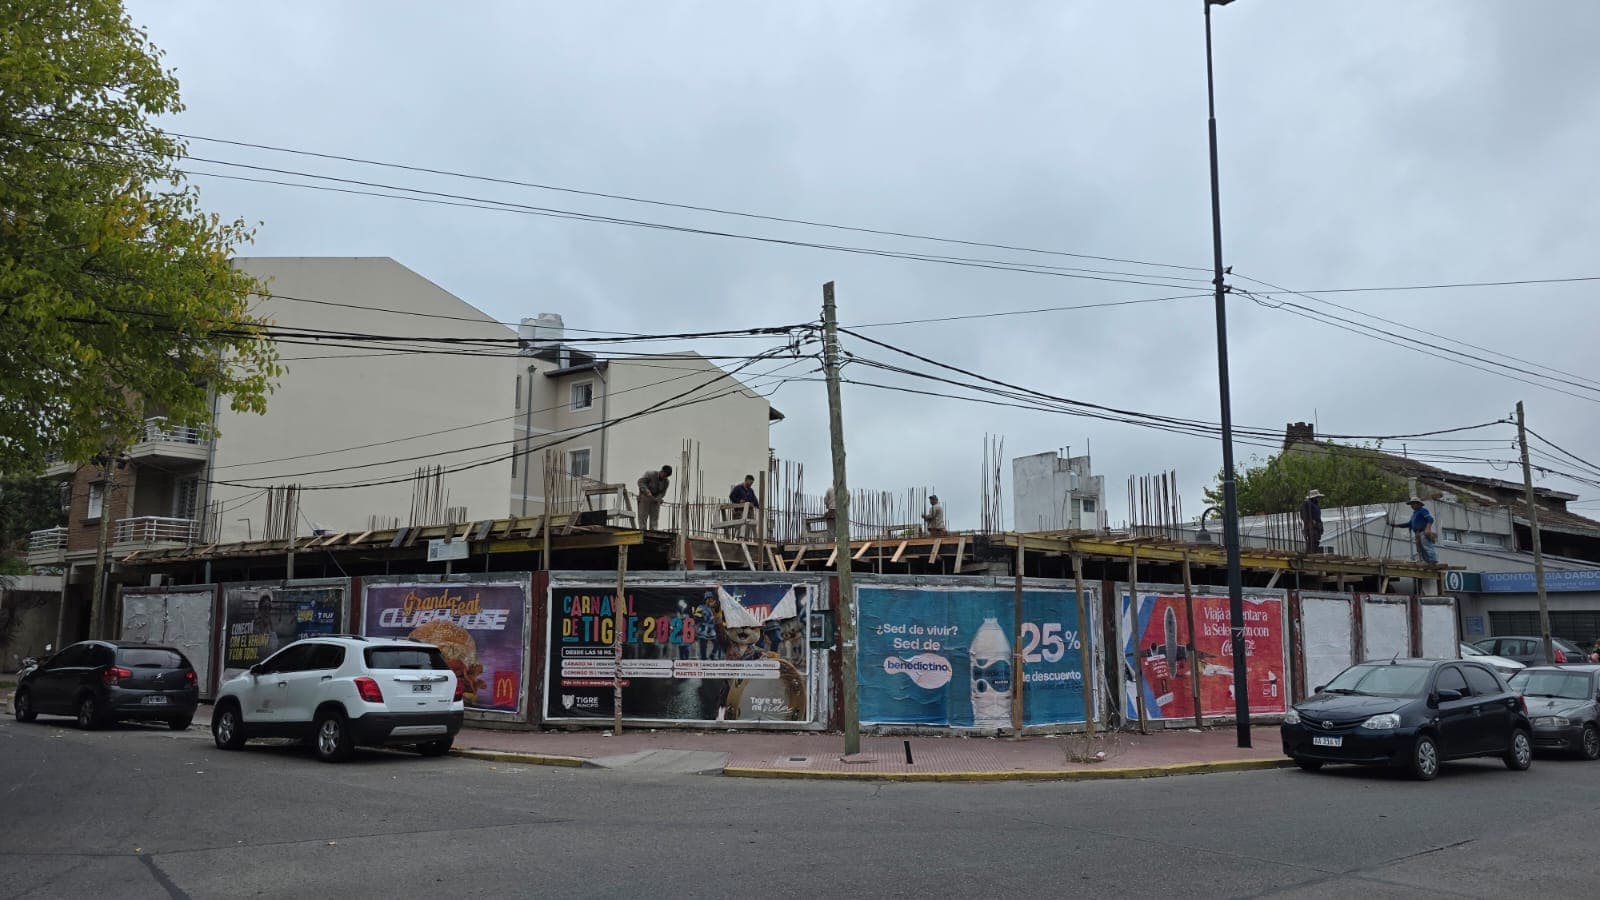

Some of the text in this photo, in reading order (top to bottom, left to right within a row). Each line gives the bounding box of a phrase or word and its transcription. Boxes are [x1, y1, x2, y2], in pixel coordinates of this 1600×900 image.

[403, 589, 450, 616] Grand
[1204, 606, 1225, 622] Viajá
[1262, 612, 1268, 622] a
[562, 618, 580, 636] DE
[643, 616, 696, 645] 2026
[876, 623, 959, 636] ¿Sed de vivir?
[1204, 623, 1212, 636] la
[1253, 627, 1270, 637] con
[893, 637, 941, 651] Sed de
[1021, 622, 1081, 663] 25%
[887, 660, 948, 671] benedictino
[1031, 670, 1082, 681] descuento
[750, 696, 771, 705] Tigre
[752, 703, 762, 711] mi
